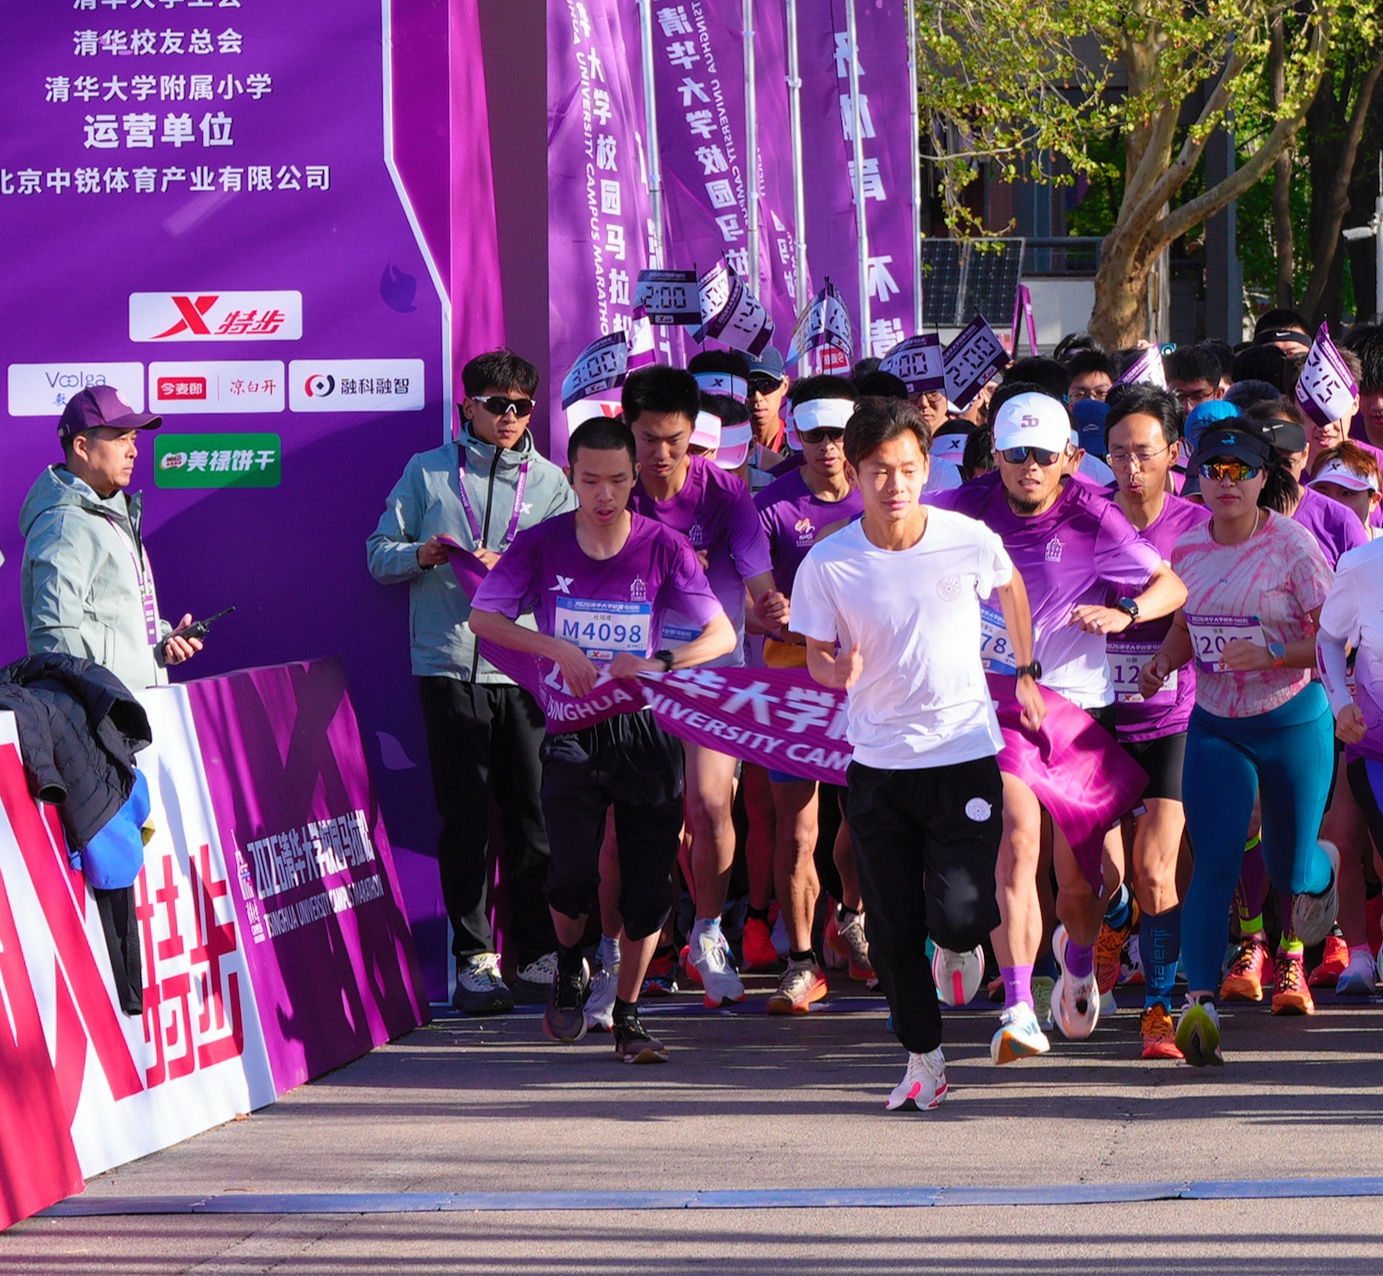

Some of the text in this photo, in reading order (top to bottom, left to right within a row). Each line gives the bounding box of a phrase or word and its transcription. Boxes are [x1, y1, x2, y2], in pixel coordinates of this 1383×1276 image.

[72, 29, 243, 56] 清华校友总会
[44, 74, 273, 102] 清华大学附属小学
[83, 112, 234, 148] 运营单位
[593, 245, 610, 336] MARATHO
[643, 285, 687, 309] 2:00
[947, 335, 997, 389] 2:00
[160, 381, 203, 397] 今麦郎
[229, 379, 277, 397] 凉白开
[340, 376, 410, 396] 融科融智
[187, 449, 276, 472] 美禄饼干
[562, 619, 642, 644] M4098
